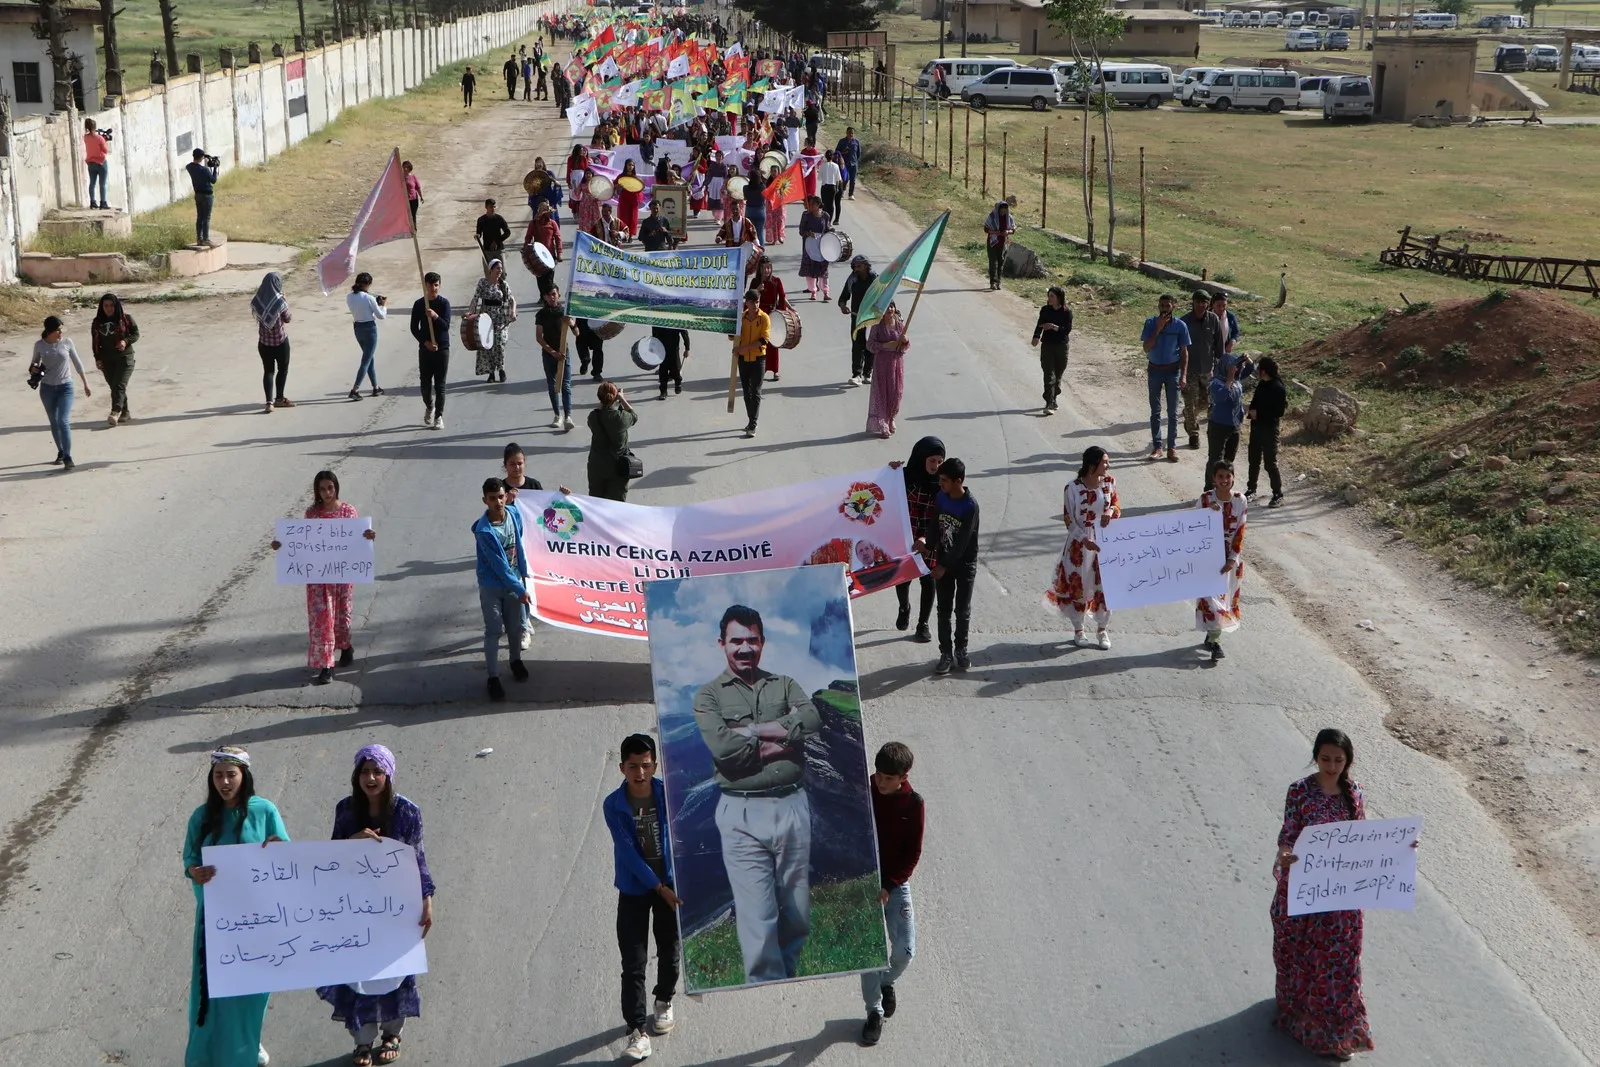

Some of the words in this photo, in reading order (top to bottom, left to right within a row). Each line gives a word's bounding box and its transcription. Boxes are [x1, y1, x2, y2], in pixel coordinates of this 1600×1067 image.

[686, 256, 698, 269] LI
[616, 546, 682, 562] CENGA
[574, 593, 637, 613] الحرية
[252, 862, 298, 883] القادة
[313, 862, 340, 886] هم
[357, 849, 405, 878] كريلا
[216, 902, 288, 932] الحقيقيون
[294, 894, 405, 923] والفدائيون
[219, 935, 302, 967] كردستان
[309, 927, 371, 953] لقضية
